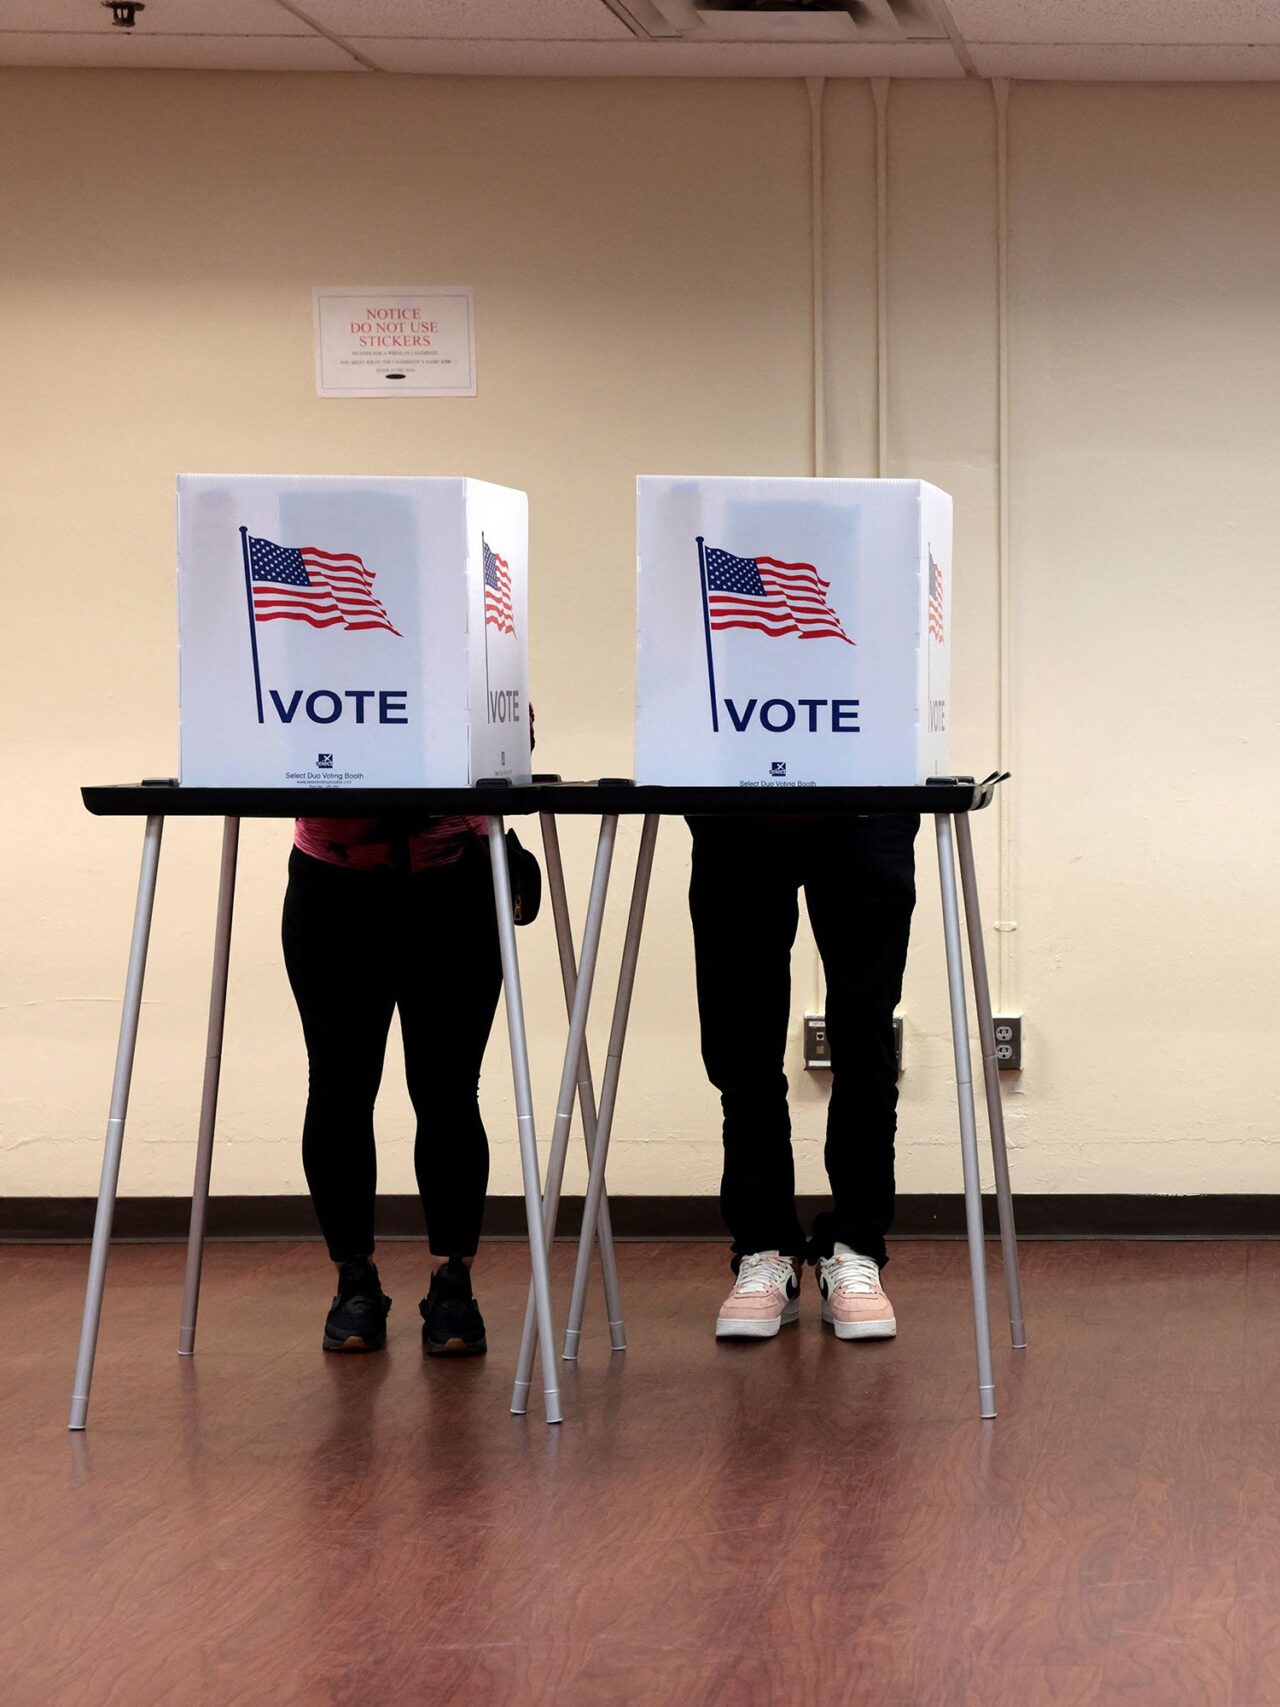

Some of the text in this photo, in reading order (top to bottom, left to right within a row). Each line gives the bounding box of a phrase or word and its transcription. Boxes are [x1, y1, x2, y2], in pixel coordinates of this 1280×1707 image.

[367, 308, 421, 320] NOTICE
[350, 321, 439, 333] DO NOT USE
[359, 335, 431, 347] STICKERS
[269, 690, 408, 724] VOTE
[490, 690, 520, 723] VOTE
[724, 699, 860, 732] VOTE
[322, 772, 343, 780] Voting
